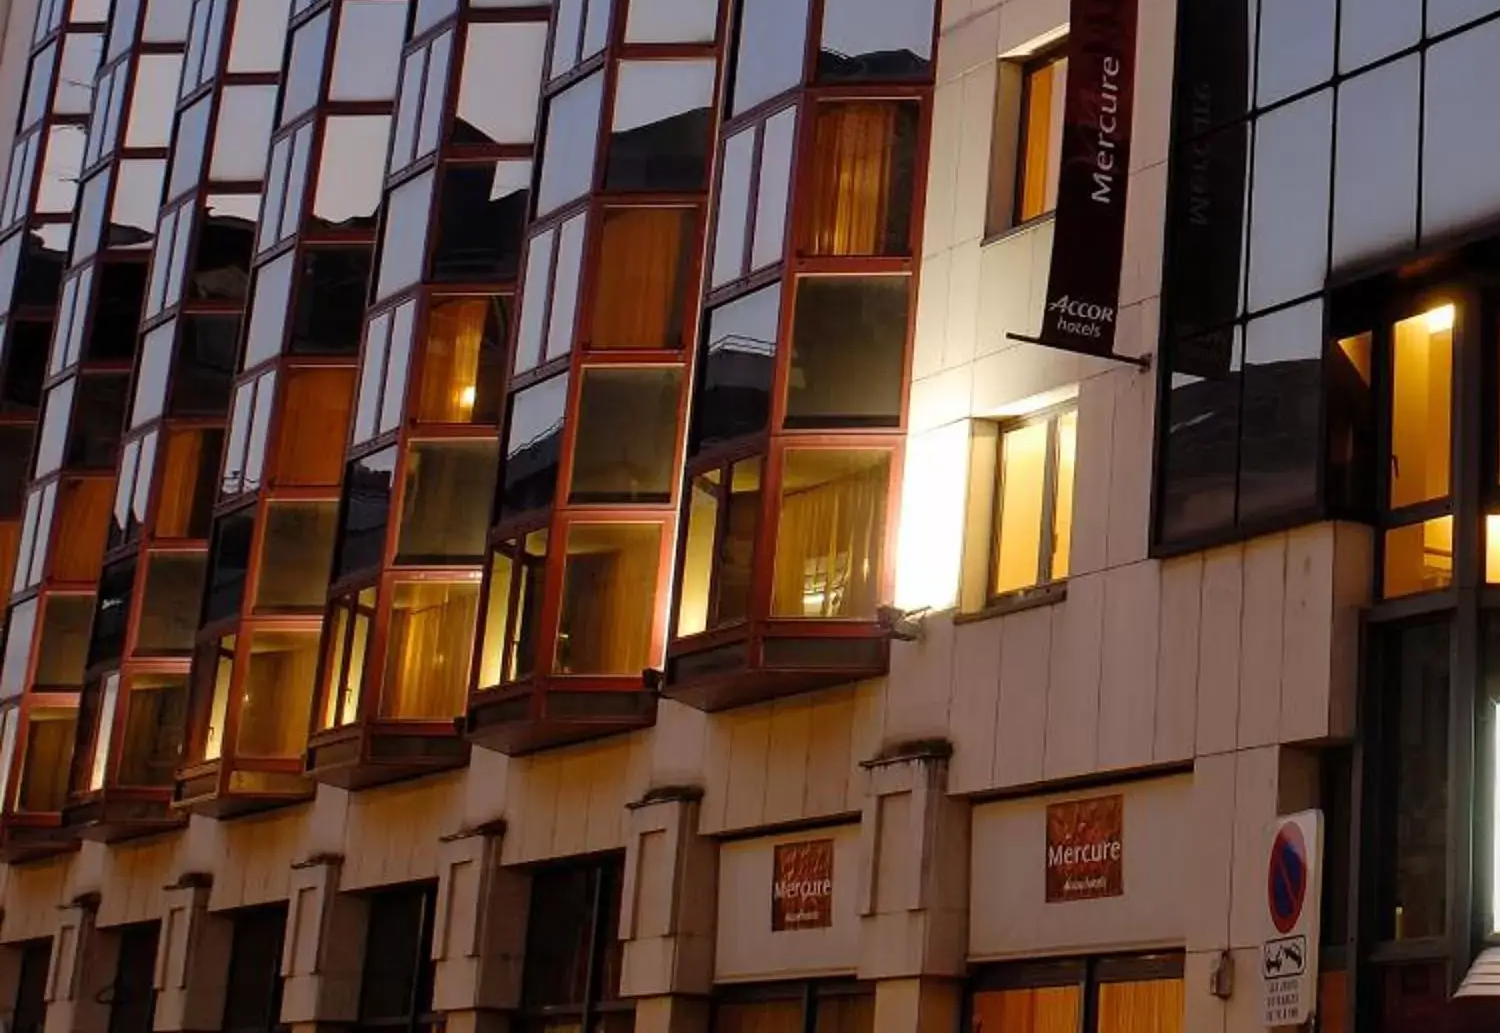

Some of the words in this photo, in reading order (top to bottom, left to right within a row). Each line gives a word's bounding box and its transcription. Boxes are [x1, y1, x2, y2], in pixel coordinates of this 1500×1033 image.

[1091, 55, 1120, 205] Mercure
[1056, 317, 1102, 339] hotels
[1048, 840, 1122, 868] Mercure
